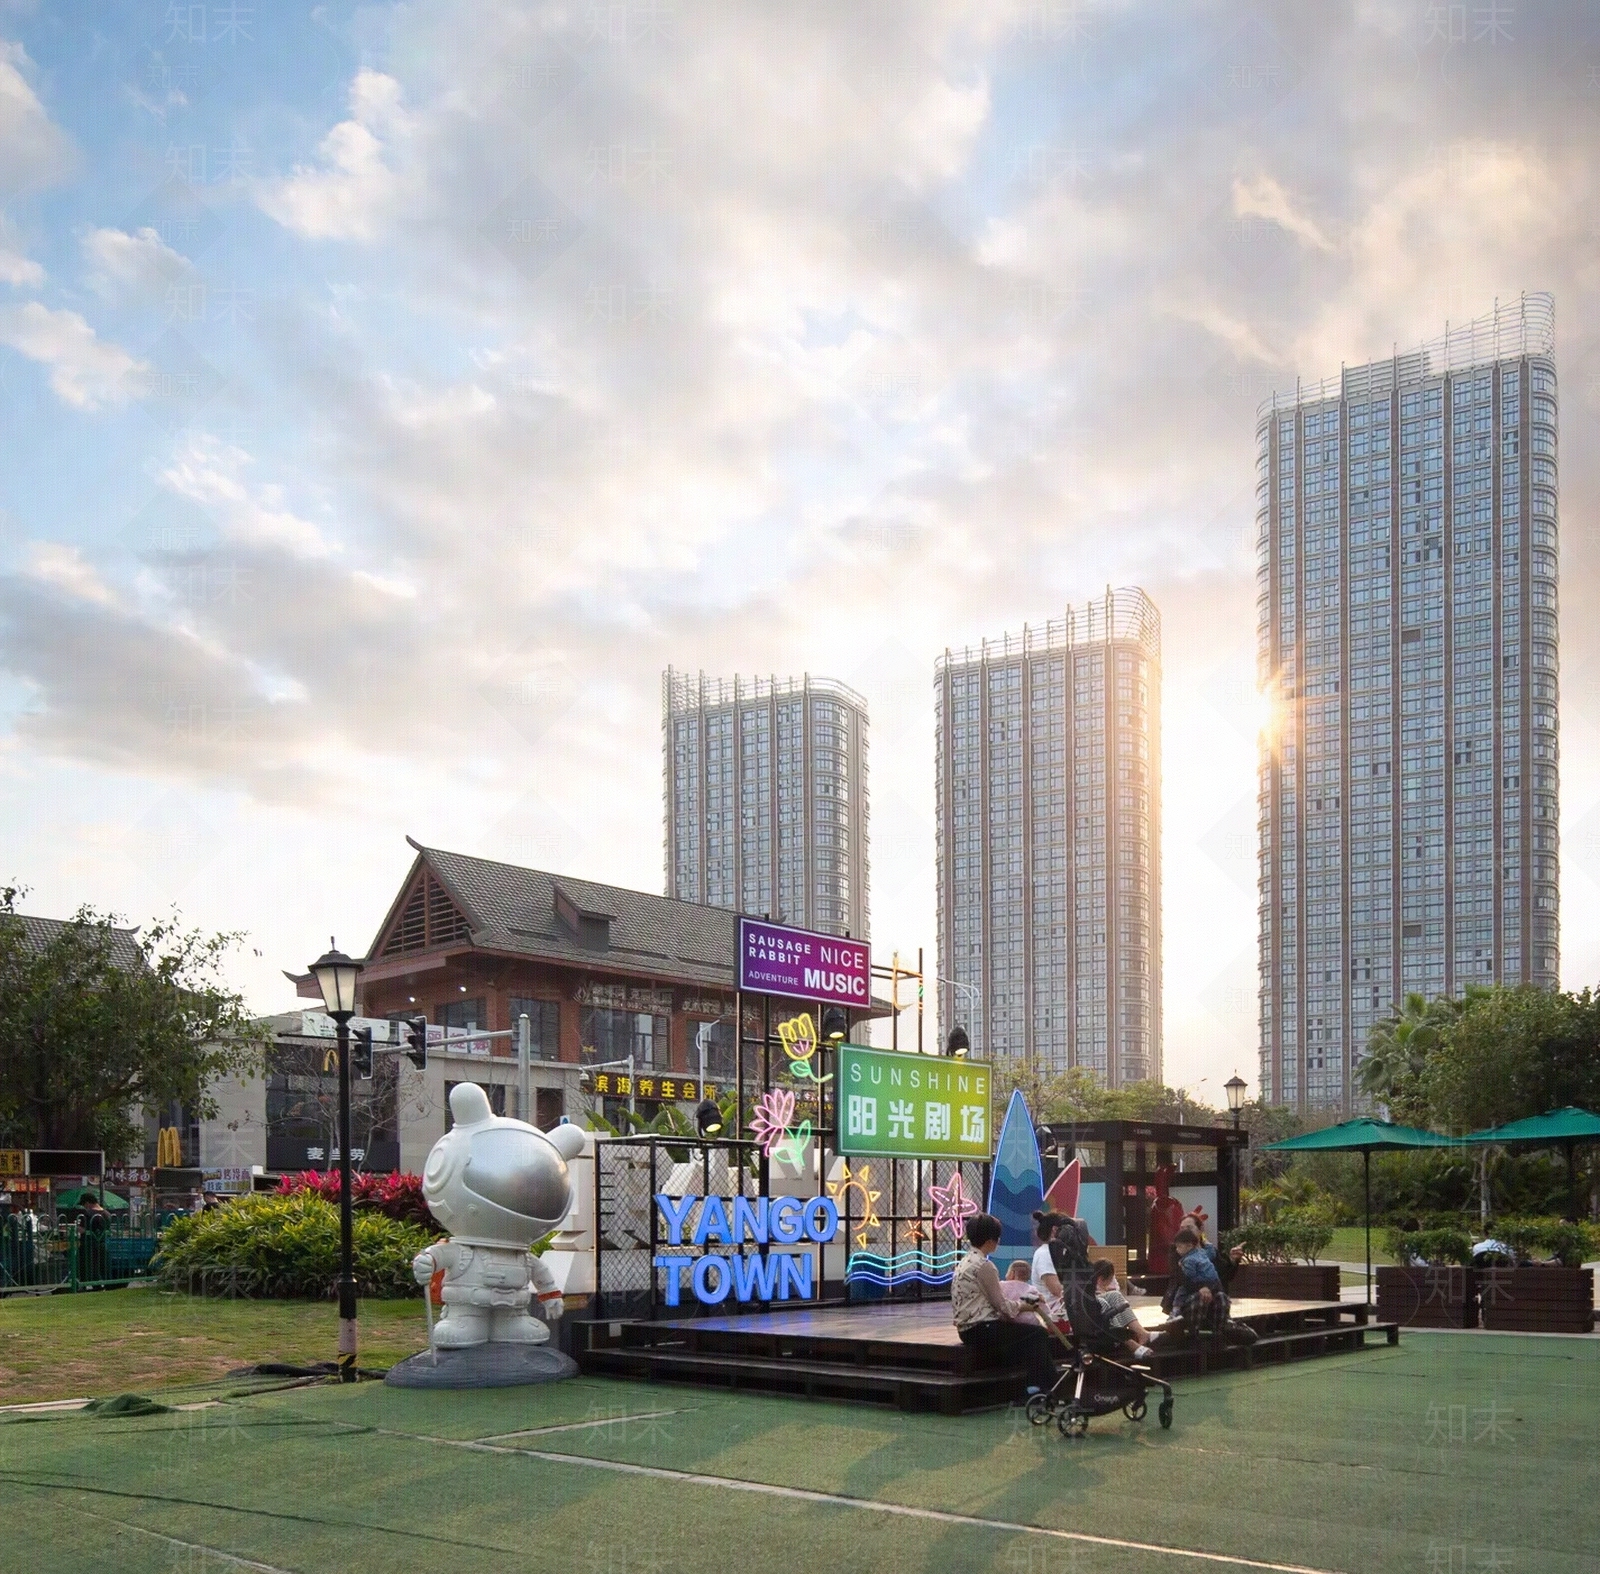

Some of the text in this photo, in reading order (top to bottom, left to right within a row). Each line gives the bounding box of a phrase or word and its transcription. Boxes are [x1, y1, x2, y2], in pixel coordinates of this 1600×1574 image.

[748, 932, 811, 955] SAUSAGE
[748, 946, 800, 966] RABBIT
[820, 945, 864, 970] NICE
[748, 970, 799, 986] ADVENTURE
[804, 967, 865, 996] MUSIC
[594, 1074, 718, 1100] 滨海养生会所
[850, 1063, 985, 1095] SUNSHINE
[848, 1095, 985, 1143] 阳光剧场
[654, 1194, 838, 1245] YANGO
[653, 1253, 813, 1306] TOWN
